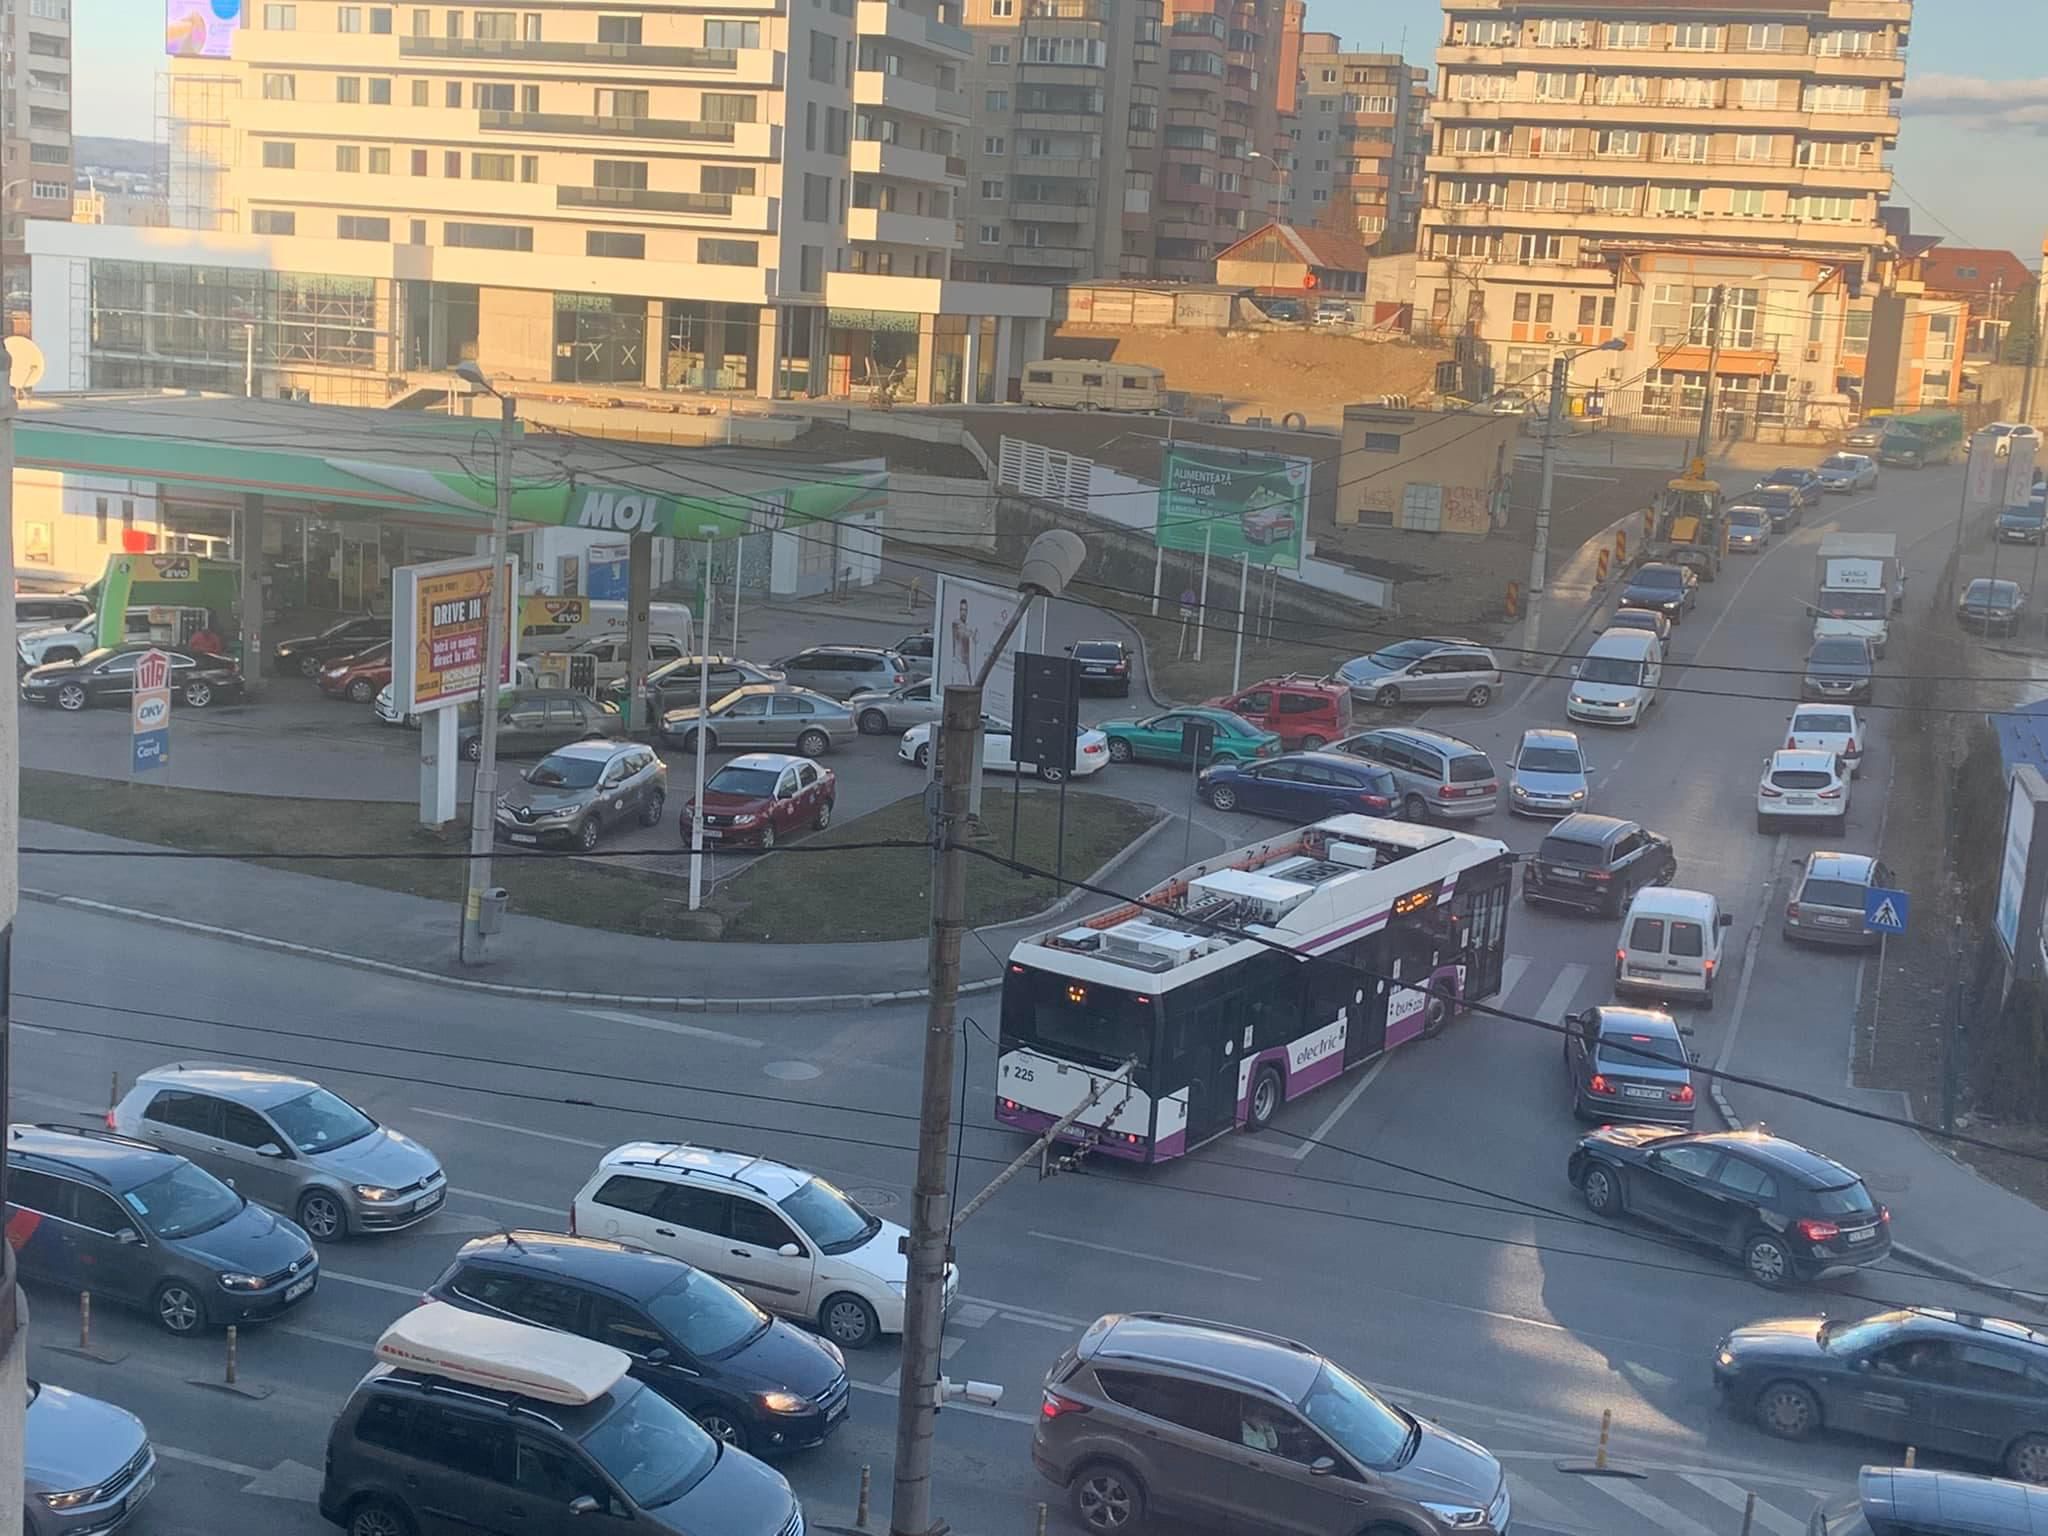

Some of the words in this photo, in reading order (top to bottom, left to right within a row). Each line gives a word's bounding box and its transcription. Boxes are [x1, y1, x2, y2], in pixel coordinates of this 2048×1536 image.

[578, 491, 659, 533] MOL
[433, 602, 466, 626] DRIVE
[469, 598, 481, 619] IN
[558, 614, 580, 623] EVO
[433, 652, 454, 667] direct
[140, 703, 164, 719] DKV
[1297, 1034, 1337, 1065] electric
[1014, 1066, 1035, 1082] 225
